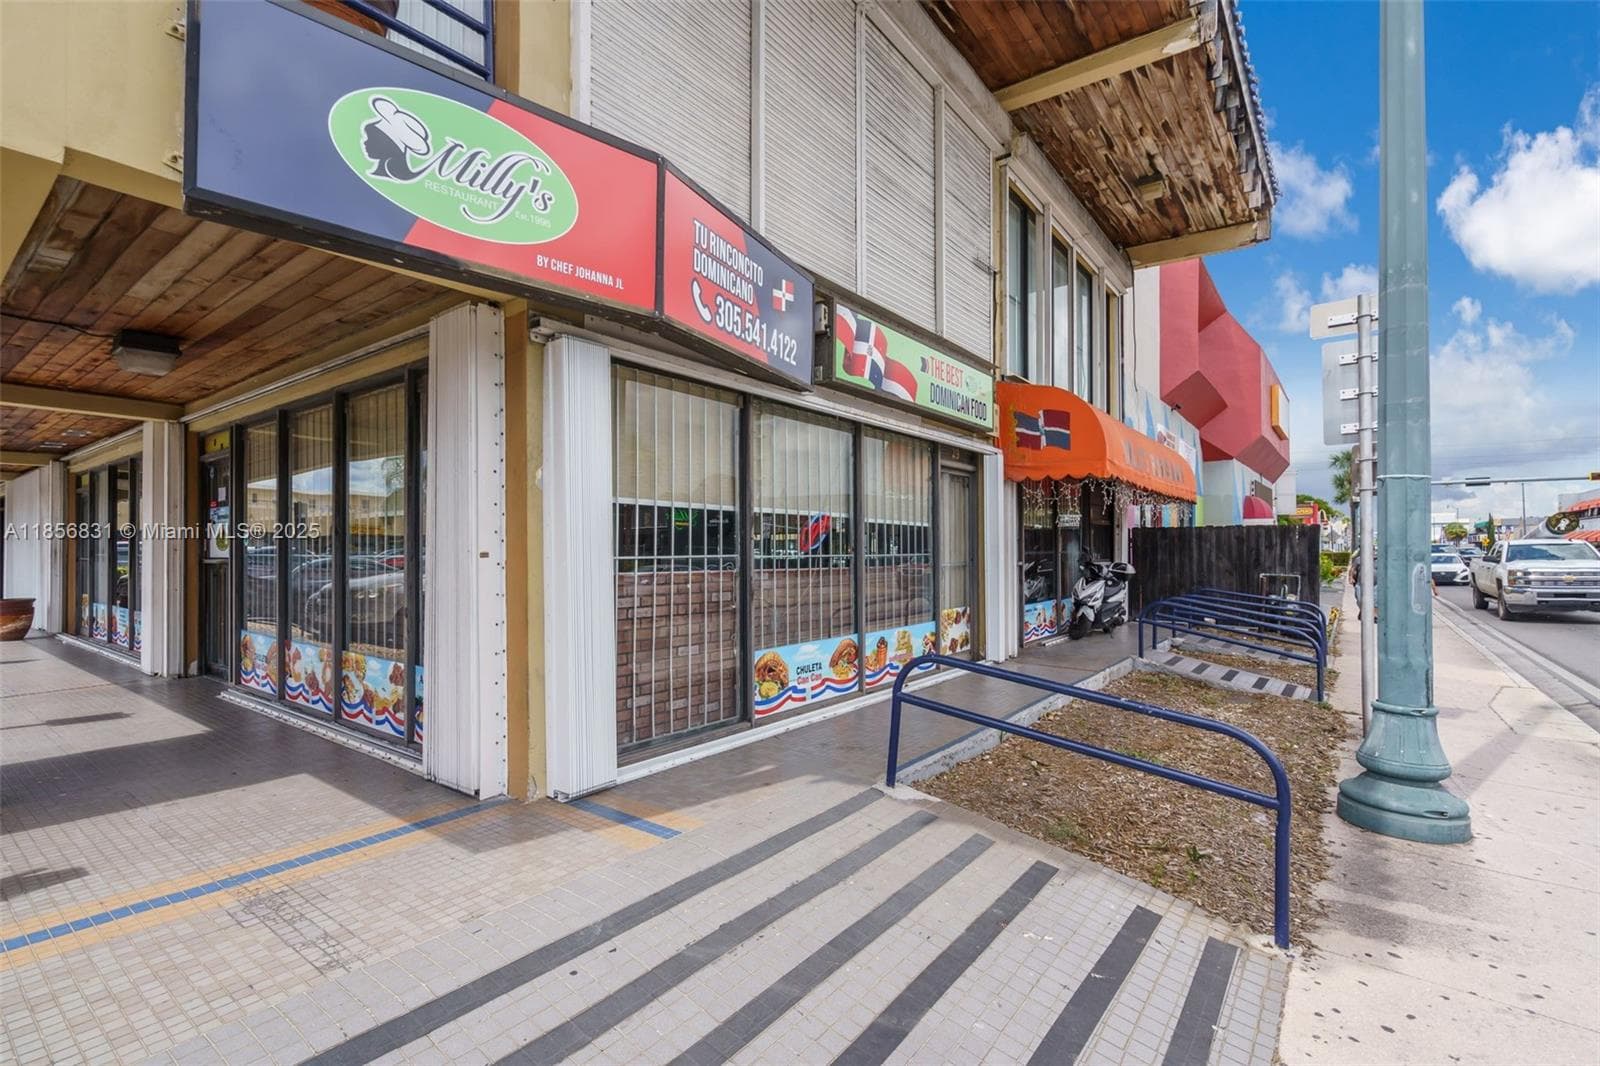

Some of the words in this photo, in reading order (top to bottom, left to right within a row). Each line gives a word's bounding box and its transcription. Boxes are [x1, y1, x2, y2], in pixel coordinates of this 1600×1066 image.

[424, 180, 498, 211] RESTAURANT
[431, 137, 554, 225] Milly's
[536, 254, 549, 269] BY
[550, 258, 574, 275] CHEF
[575, 266, 614, 287] JOHANNA
[615, 277, 625, 290] JL
[693, 219, 708, 249] TU
[709, 231, 764, 287] RINCONCITO
[693, 248, 754, 305] DOMINICANO
[715, 295, 797, 366] 305.541.4122
[930, 356, 945, 382] THE
[945, 363, 964, 389] BEST
[930, 382, 970, 416] DOMINICAN
[970, 398, 987, 421] FOOD
[796, 661, 823, 676] CHULETA
